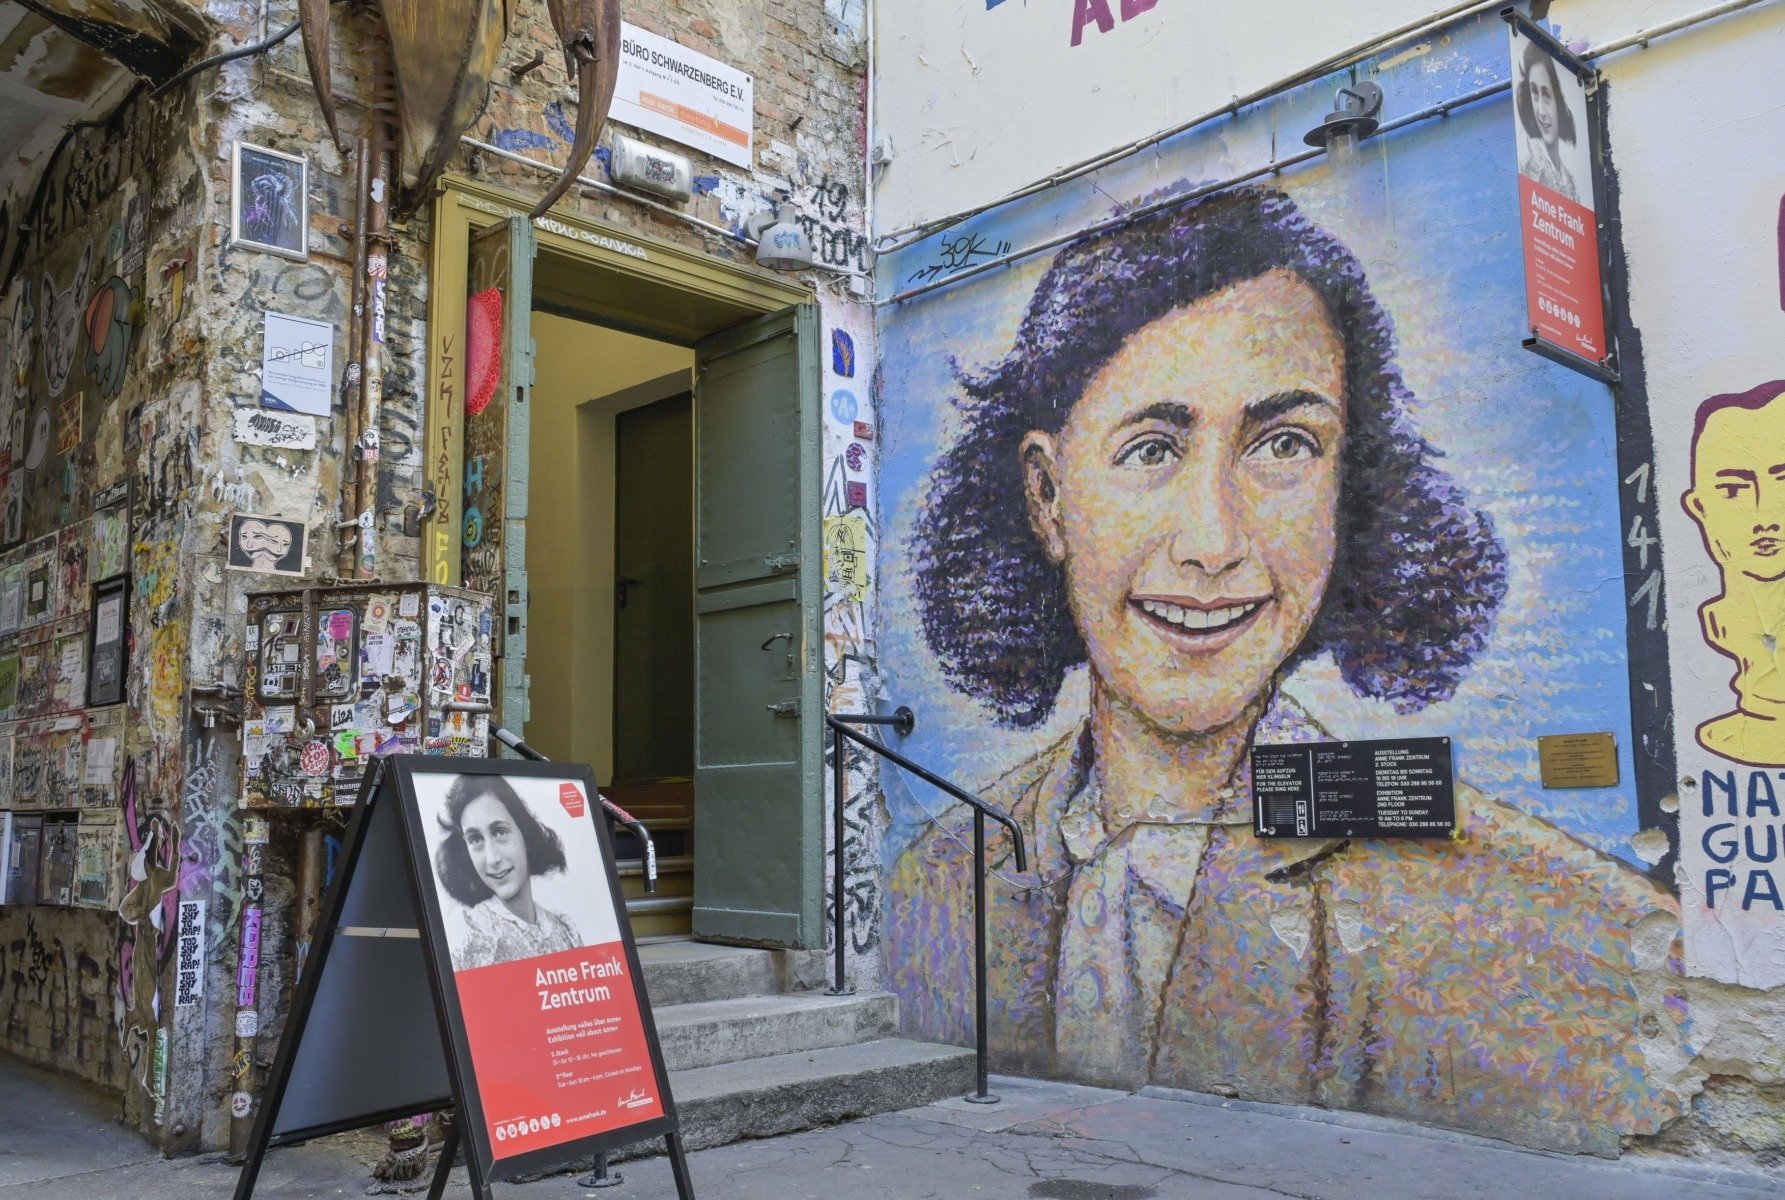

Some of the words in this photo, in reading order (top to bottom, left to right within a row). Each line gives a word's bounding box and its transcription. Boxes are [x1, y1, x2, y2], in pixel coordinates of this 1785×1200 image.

[622, 39, 649, 62] BÜRO
[652, 51, 728, 98] SCHWARZENBERG
[730, 84, 744, 101] E.V.
[1532, 190, 1556, 218] Anne
[1559, 206, 1584, 236] Frank
[1532, 210, 1574, 249] Zentrum
[1702, 769, 1785, 818] NA
[1701, 823, 1785, 864] GU
[182, 904, 197, 912] TOO
[182, 911, 199, 920] SHY
[182, 926, 200, 936] RAP!
[181, 937, 196, 945] TOO
[181, 944, 198, 954] SHY
[180, 959, 200, 970] RAP!
[535, 968, 578, 987] Anne
[580, 956, 623, 980] Frank
[180, 979, 197, 988] SHY
[538, 985, 611, 1010] Zentrum
[546, 1023, 576, 1035] Ausstellung
[594, 1018, 606, 1027] über
[548, 1034, 575, 1044] Exhibition
[587, 1028, 602, 1037] about
[566, 1110, 607, 1125] www.annefrank.de
